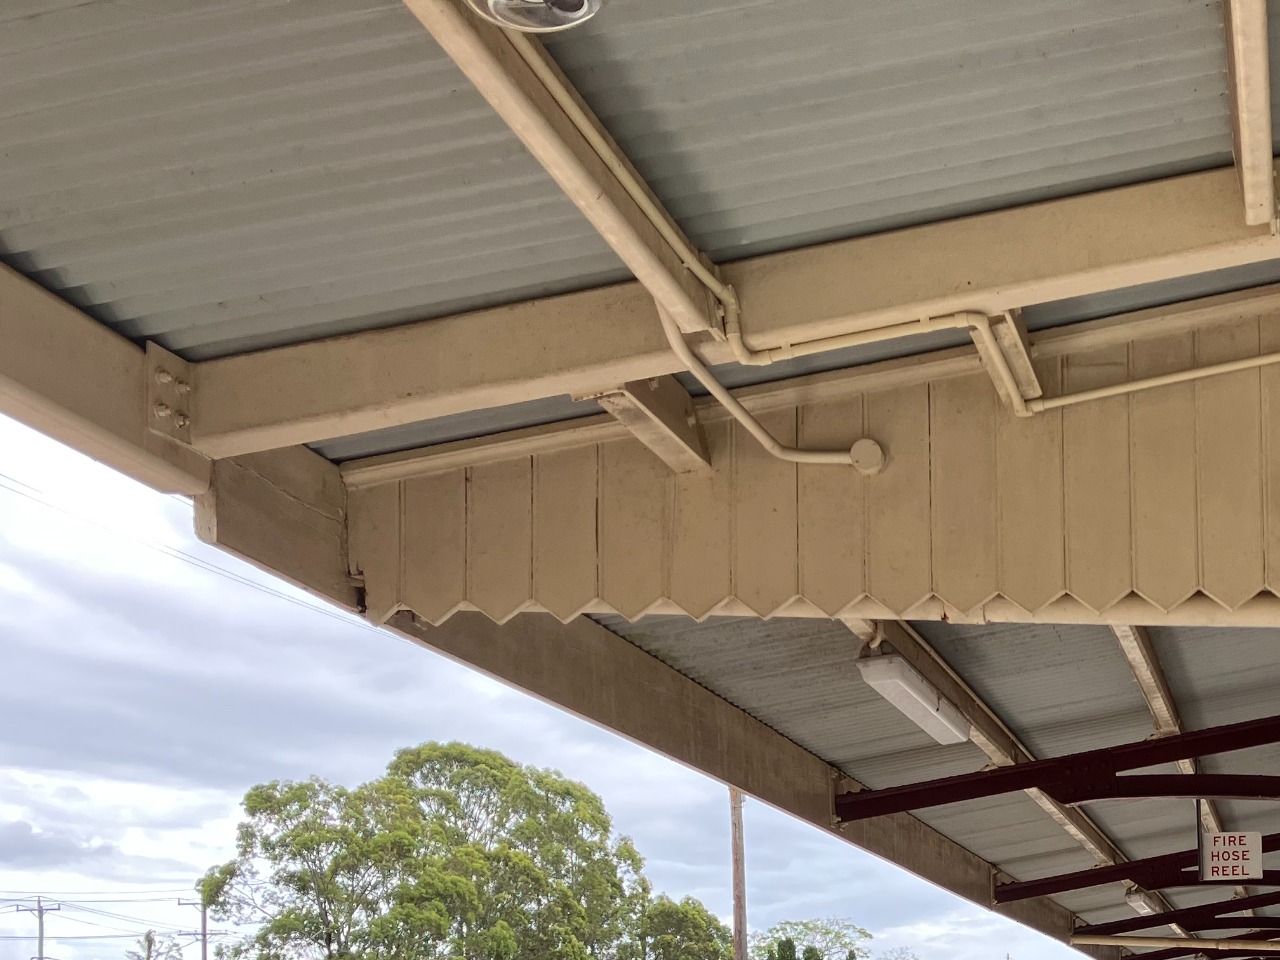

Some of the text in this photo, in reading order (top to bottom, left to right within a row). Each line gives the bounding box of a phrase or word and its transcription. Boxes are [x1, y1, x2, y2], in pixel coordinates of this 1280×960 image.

[1213, 835, 1247, 846] FIRE
[1211, 850, 1250, 861] HOSE
[1211, 865, 1249, 876] REEL
